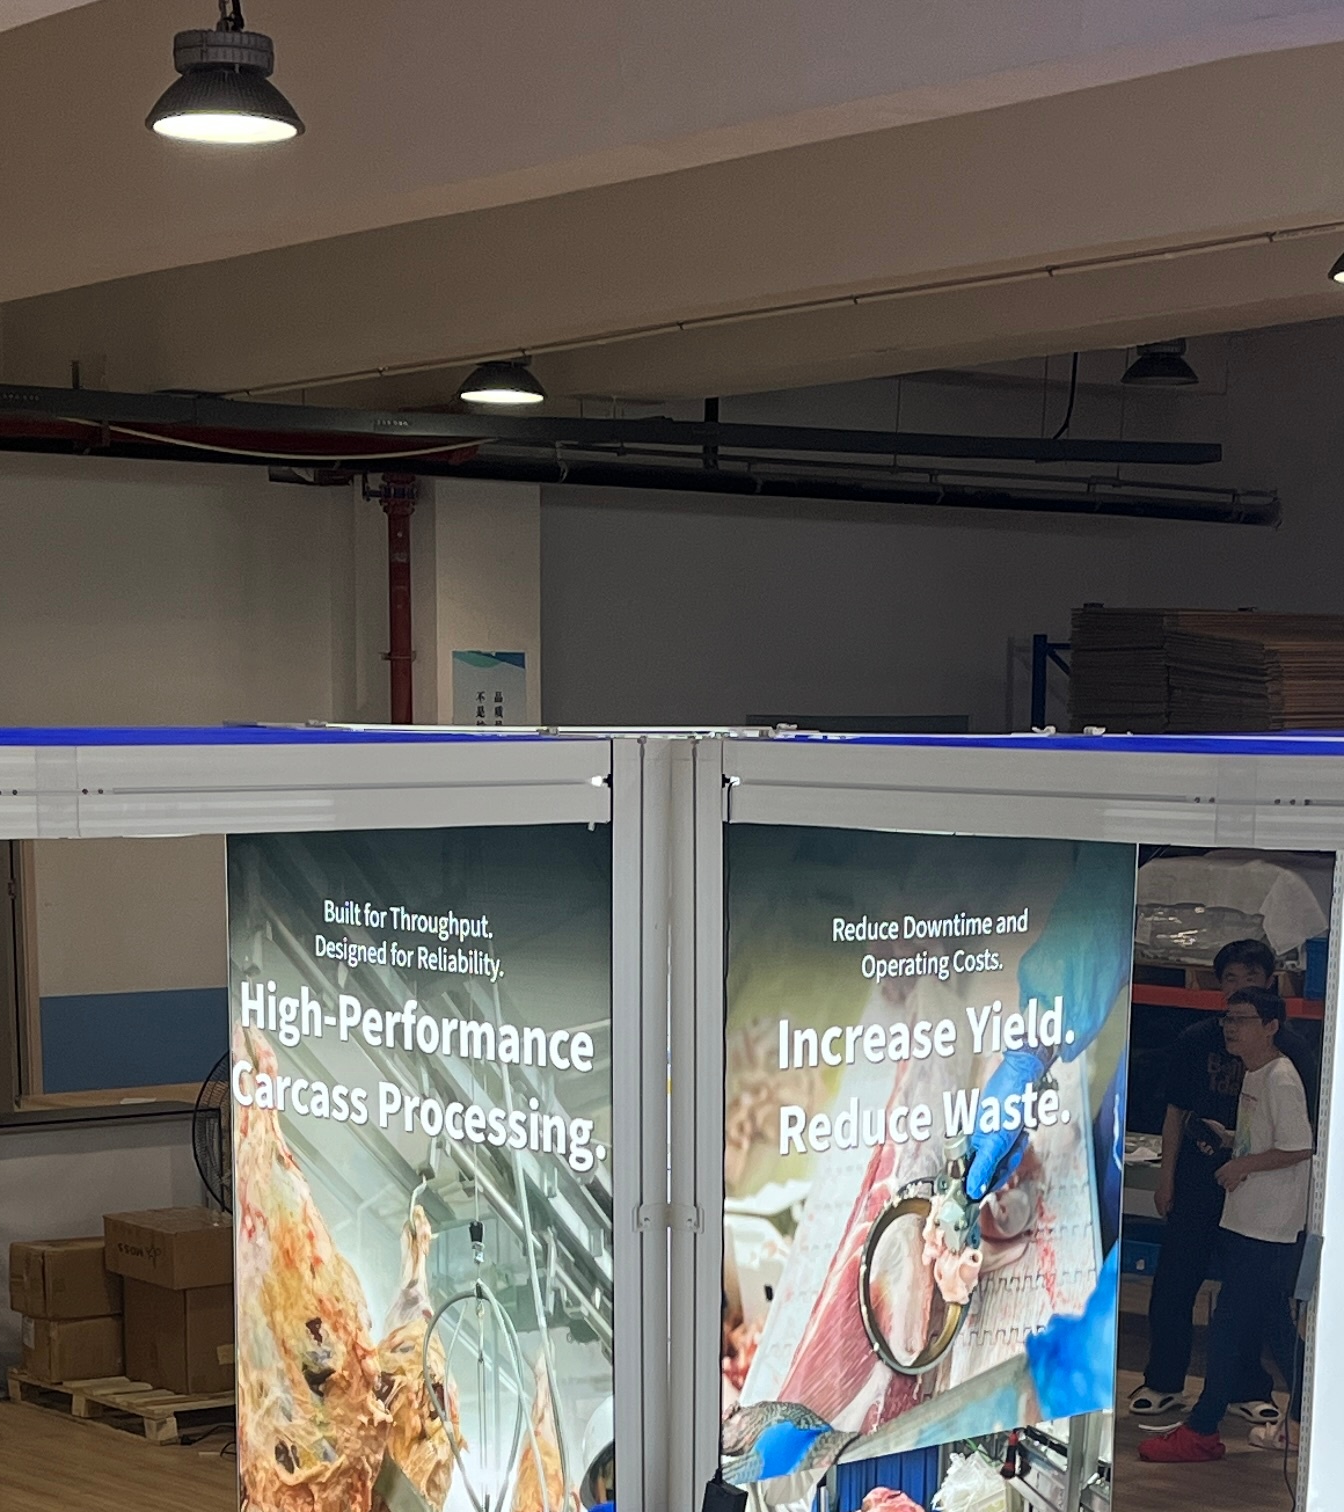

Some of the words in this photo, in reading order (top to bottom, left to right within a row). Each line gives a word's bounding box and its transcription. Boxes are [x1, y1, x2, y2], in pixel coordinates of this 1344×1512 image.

[324, 899, 361, 928] Built
[364, 902, 387, 929] for
[390, 906, 493, 941] Throughput.
[832, 917, 899, 942] Reduce
[903, 912, 993, 940] Downtime
[996, 908, 1029, 934] and
[315, 934, 387, 968] Designed
[390, 941, 415, 968] for
[417, 946, 505, 983] Reliability.
[861, 951, 949, 983] Operating
[953, 948, 1004, 973] Costs.
[240, 980, 595, 1073] High-Performance
[778, 1016, 957, 1070] Increase
[966, 995, 1076, 1055] Yield.
[232, 1059, 369, 1126] Carcass
[378, 1080, 607, 1173] Processing.
[779, 1096, 932, 1156] Reduce
[942, 1081, 1072, 1139] Waste.
